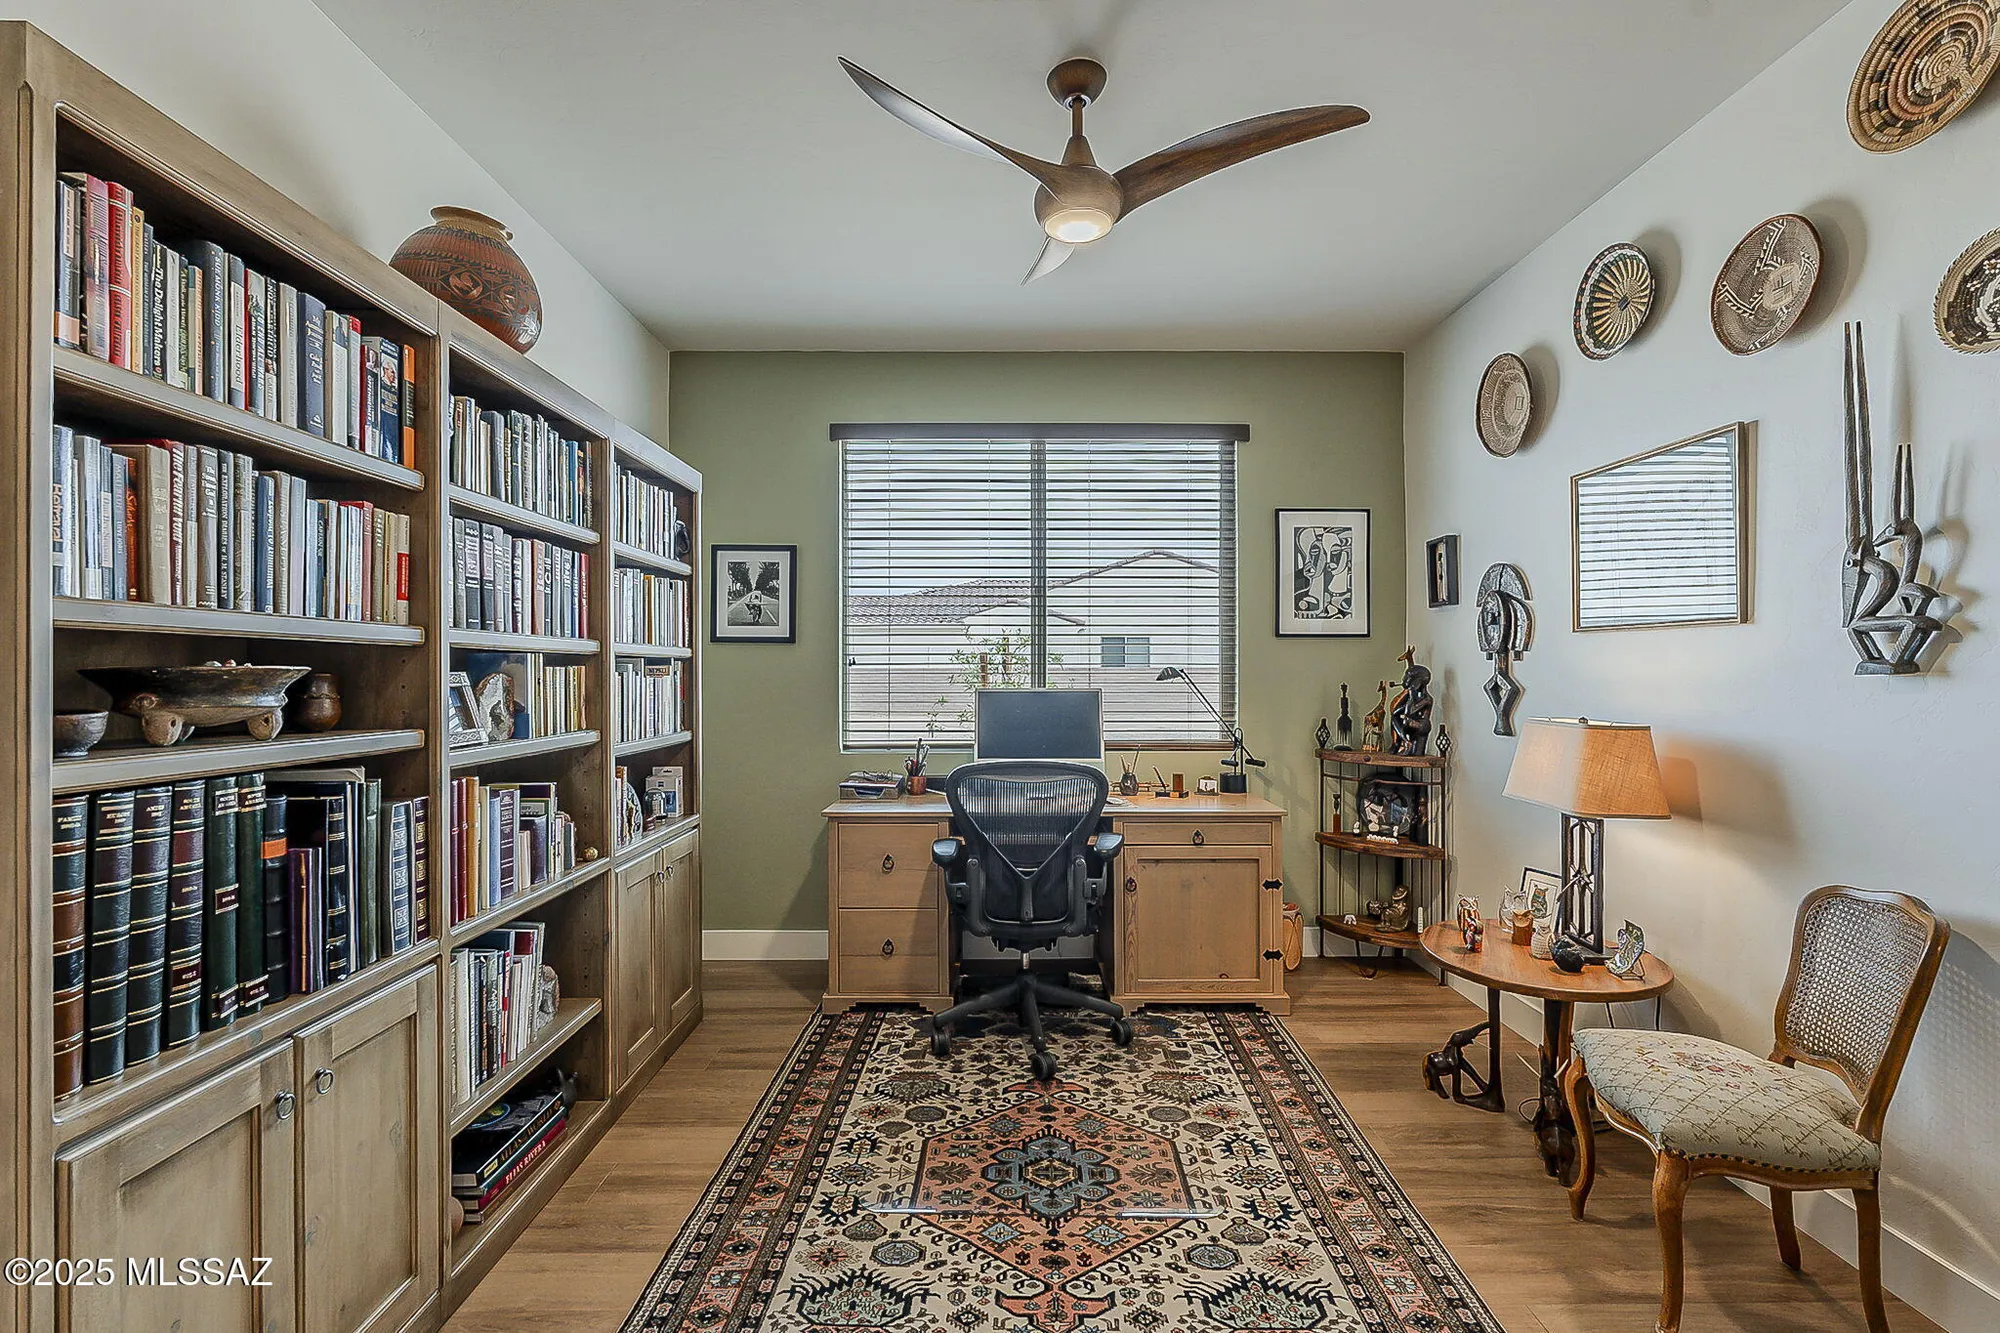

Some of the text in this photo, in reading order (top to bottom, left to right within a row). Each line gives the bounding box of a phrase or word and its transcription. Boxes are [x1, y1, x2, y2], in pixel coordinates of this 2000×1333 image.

[154, 268, 164, 289] The
[214, 257, 222, 326] SUE MONK KIDD
[153, 288, 164, 327] Delight
[154, 326, 164, 366] Makers
[235, 325, 243, 384] Elderhood
